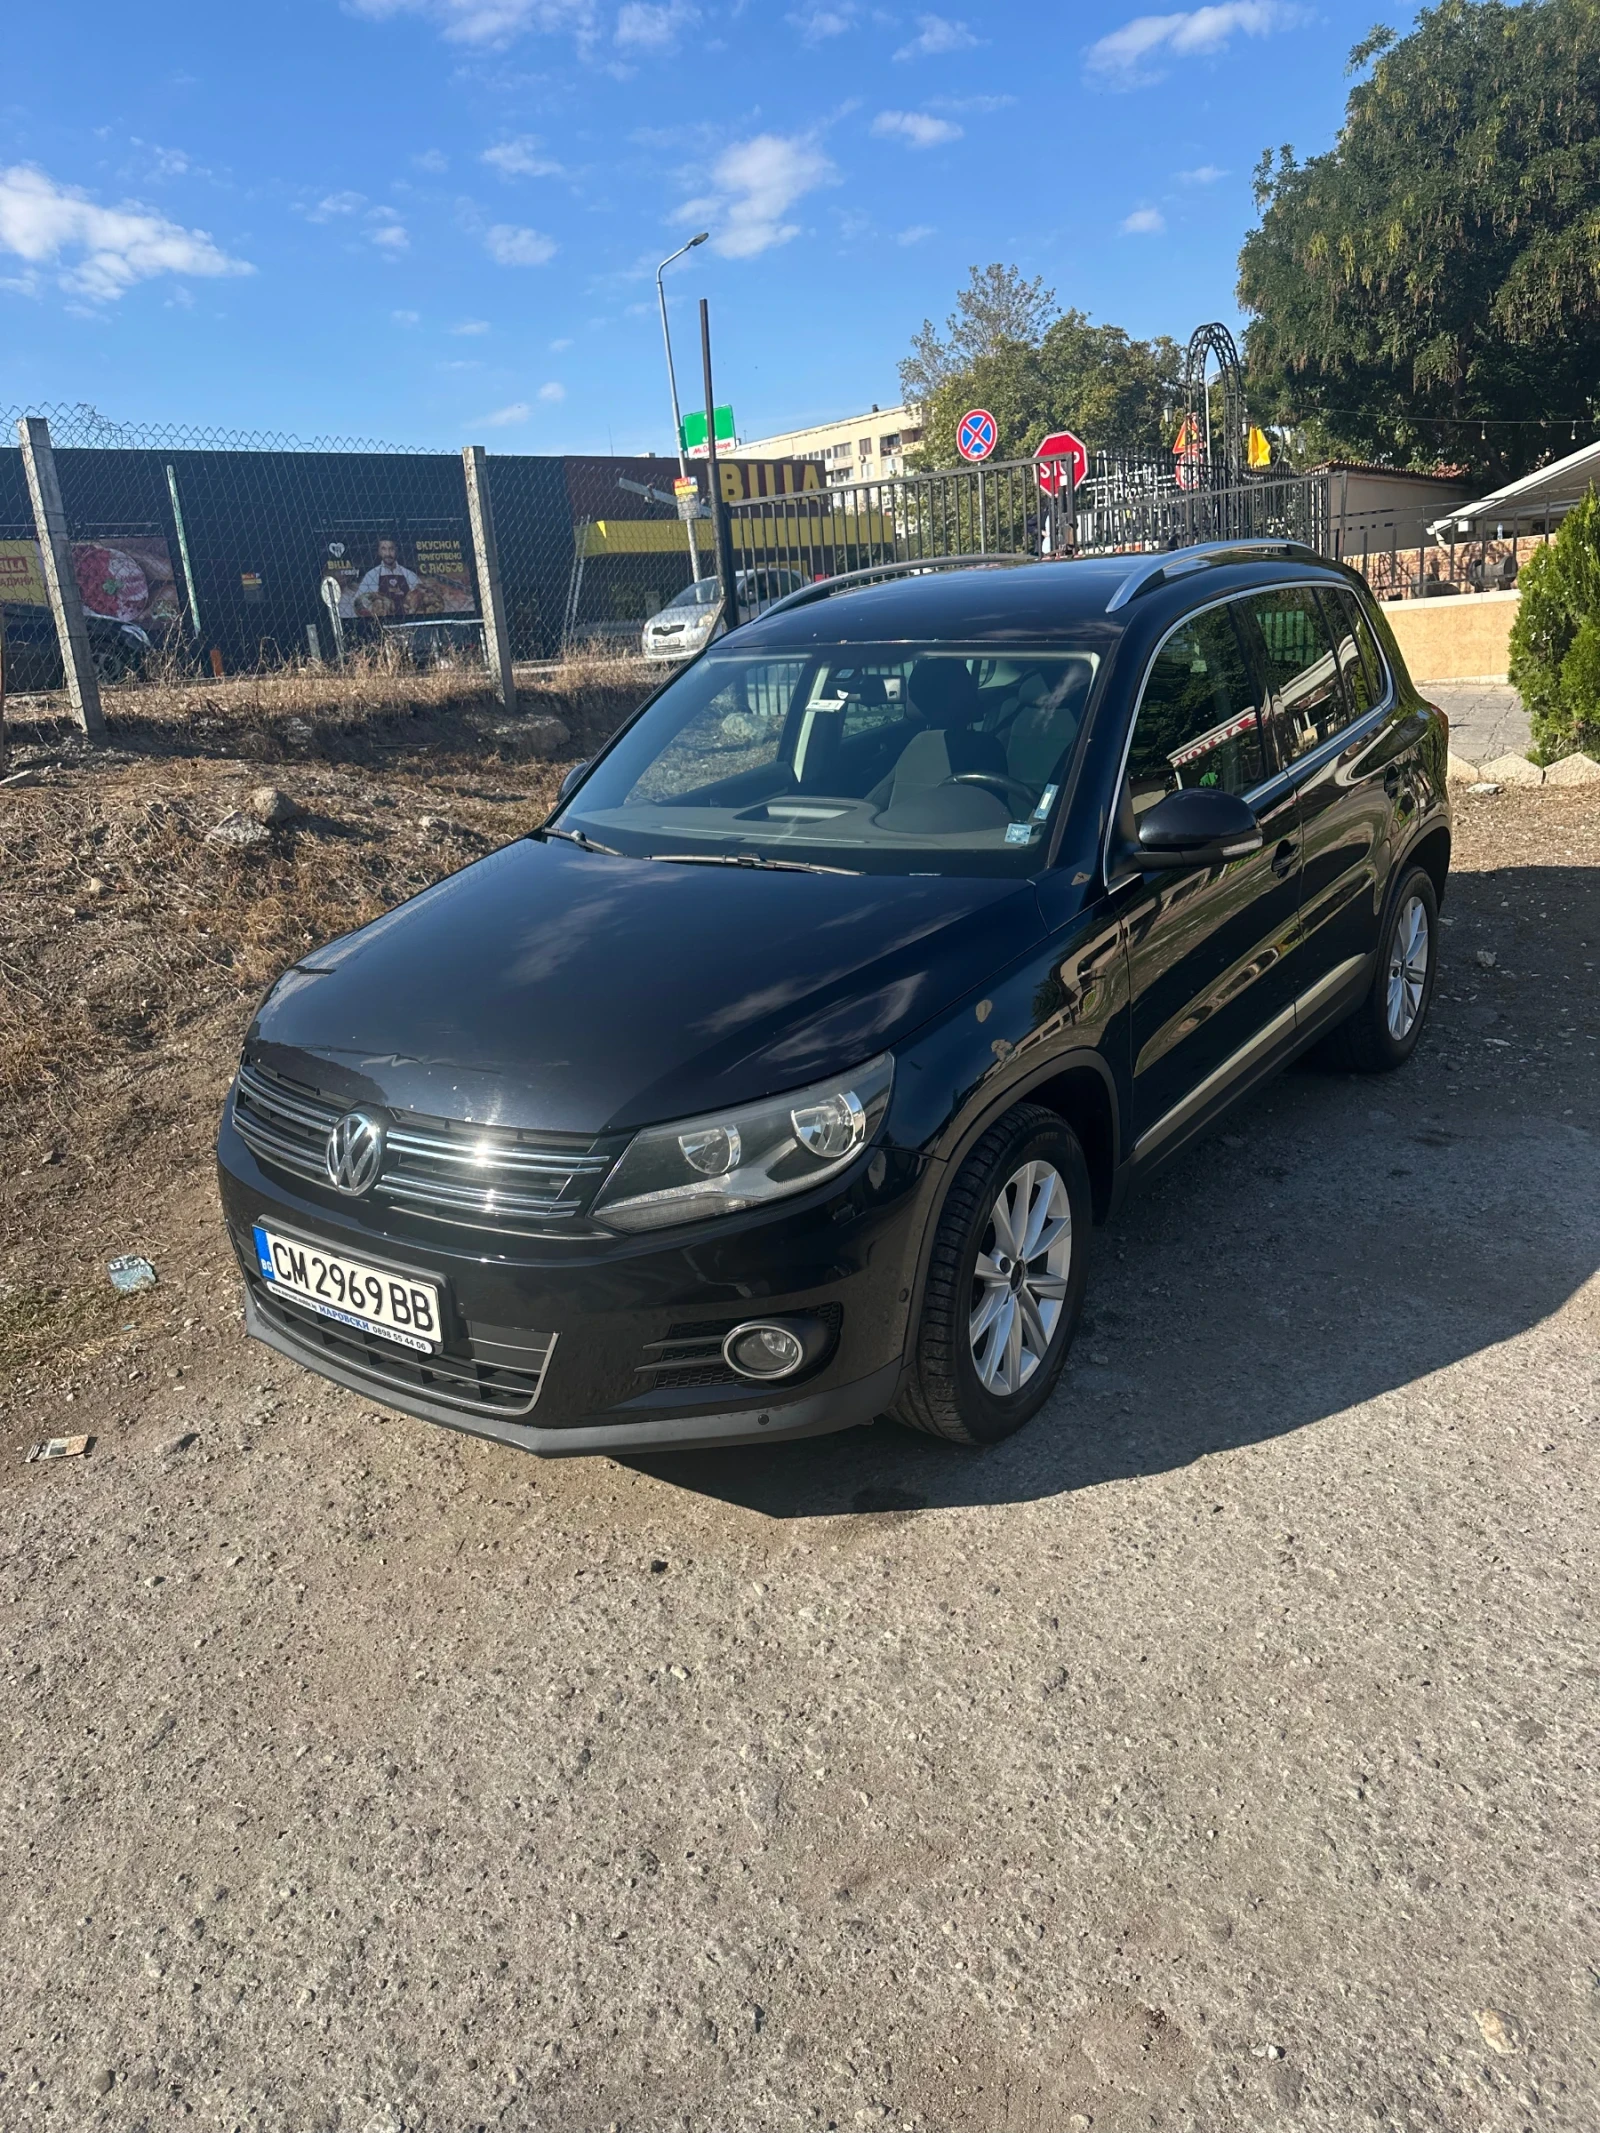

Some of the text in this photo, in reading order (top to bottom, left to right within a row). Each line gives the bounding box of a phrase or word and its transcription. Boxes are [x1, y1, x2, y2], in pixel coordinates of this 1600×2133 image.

[719, 463, 823, 505] BILLA
[416, 540, 452, 550] ВКУСНО
[327, 560, 353, 569] BILLA
[261, 1258, 273, 1272] BG
[319, 1305, 369, 1331] МАРОВСКИ
[372, 1326, 426, 1351] 0898 55 44 06
